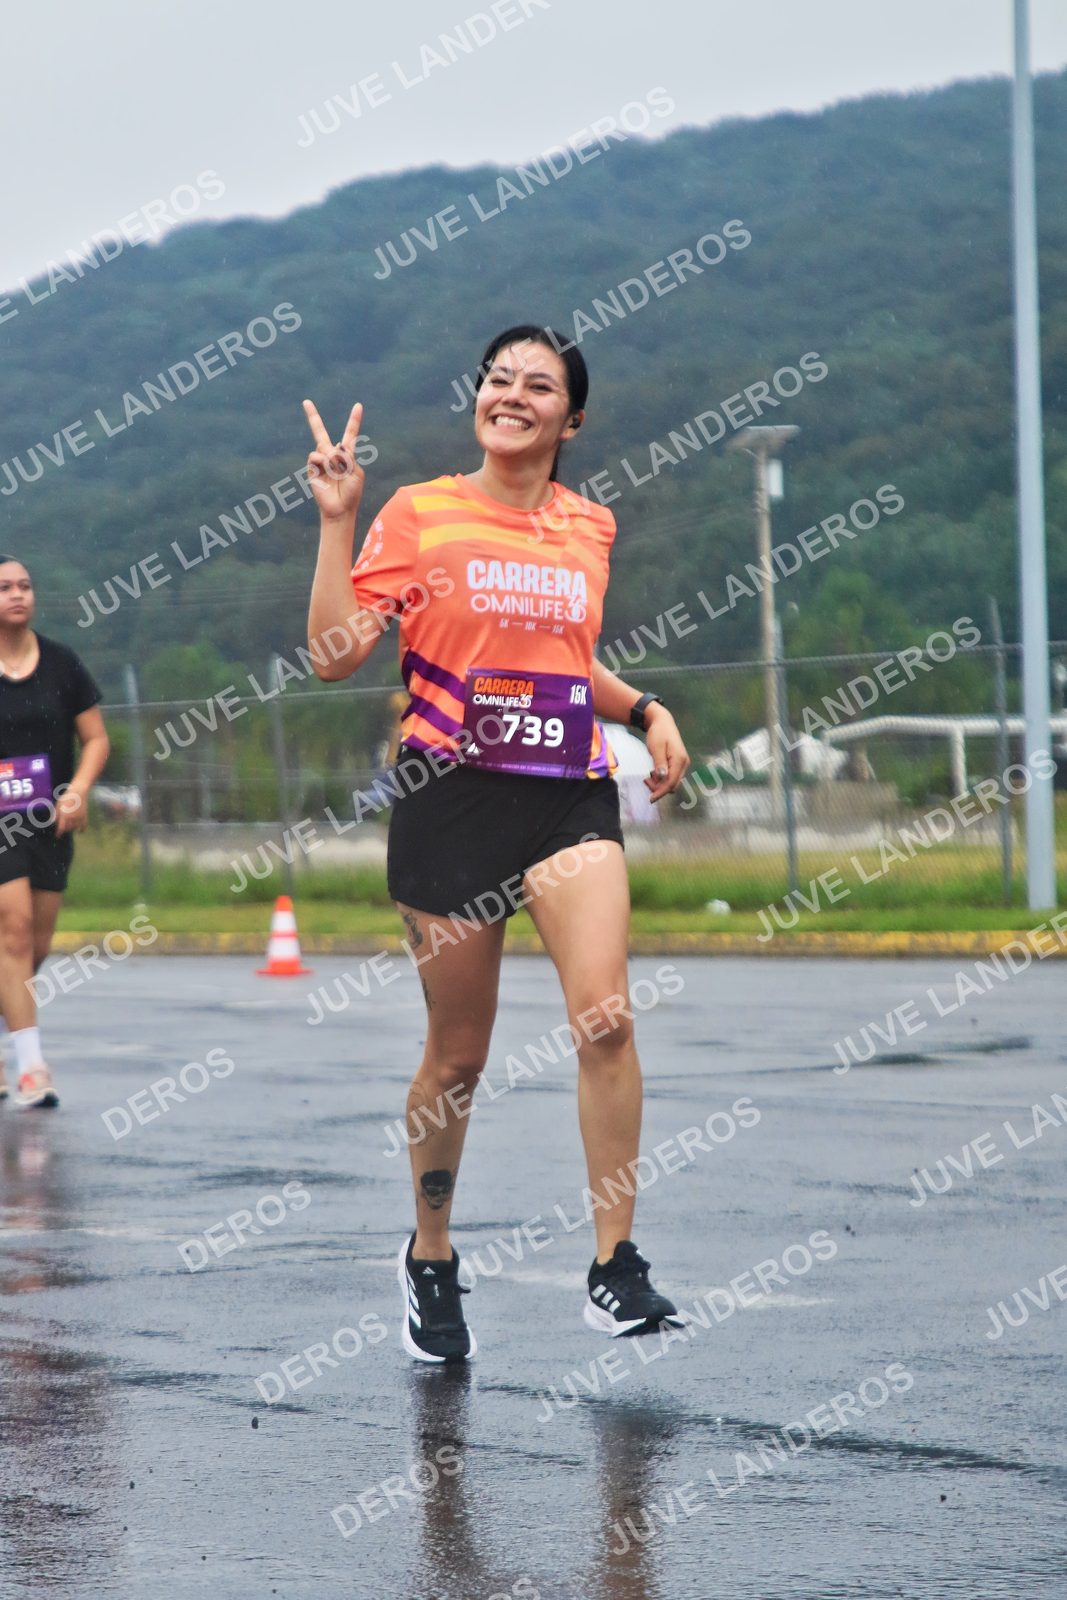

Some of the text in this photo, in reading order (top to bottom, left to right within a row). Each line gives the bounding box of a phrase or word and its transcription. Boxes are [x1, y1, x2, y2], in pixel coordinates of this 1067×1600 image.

[467, 560, 587, 606] CARRERA
[471, 593, 563, 620] OMNILIFE
[474, 677, 535, 696] CARRERA
[473, 694, 520, 708] OMNILIFE
[502, 714, 565, 747] 739
